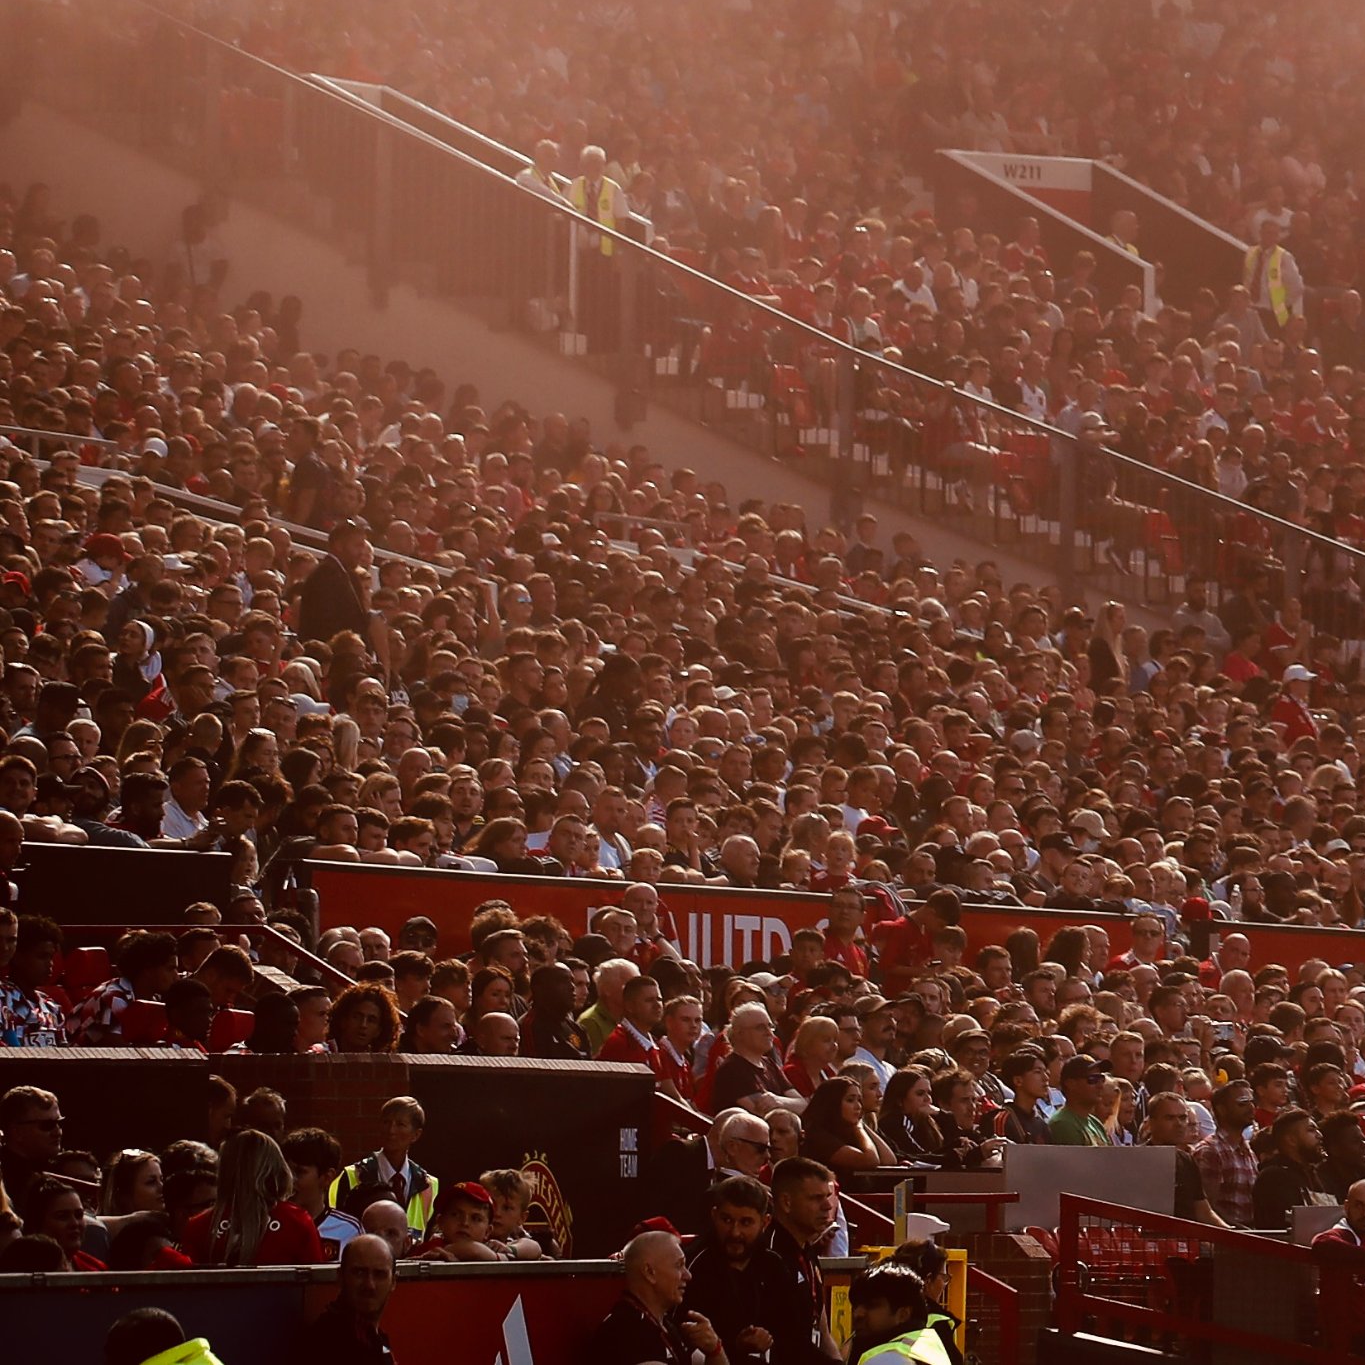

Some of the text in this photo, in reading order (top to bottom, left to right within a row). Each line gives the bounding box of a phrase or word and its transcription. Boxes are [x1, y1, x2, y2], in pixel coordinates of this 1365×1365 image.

[1003, 163, 1041, 180] W211
[620, 1128, 637, 1151] HOME
[620, 1154, 637, 1178] TEAM
